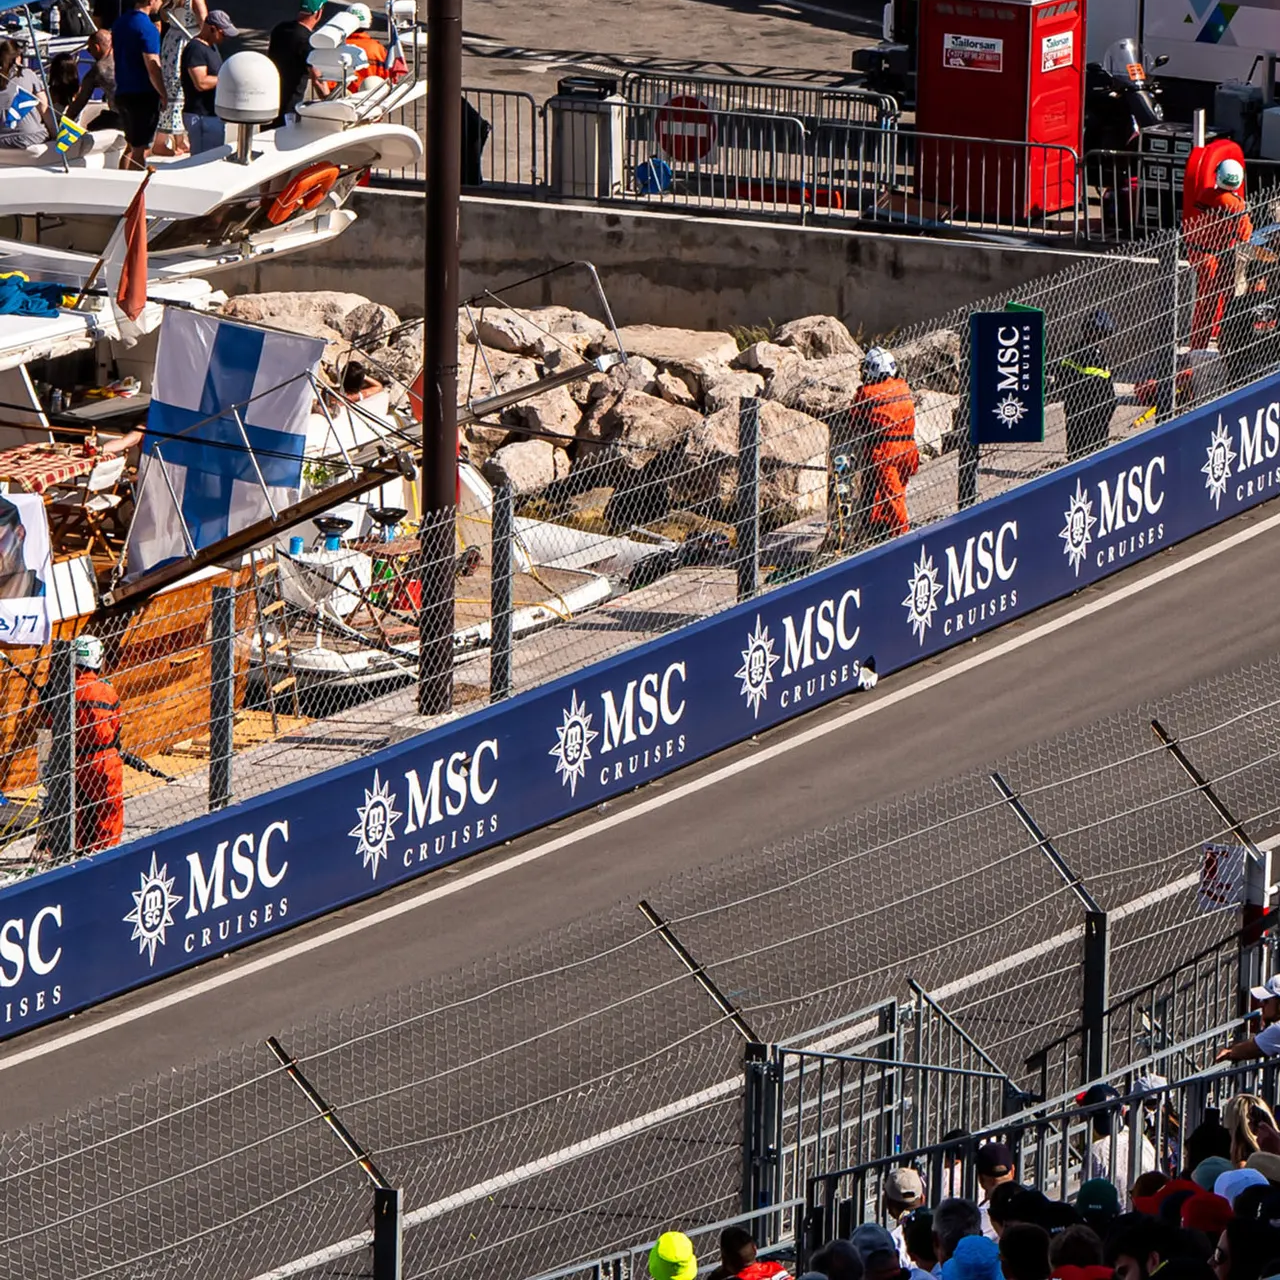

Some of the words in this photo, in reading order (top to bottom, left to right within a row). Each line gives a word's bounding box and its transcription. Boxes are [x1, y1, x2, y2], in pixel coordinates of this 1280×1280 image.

[952, 36, 996, 50] Tailorsan
[998, 327, 1019, 391] MSC
[1098, 456, 1164, 539] MSC
[945, 521, 1017, 606] MSC
[1097, 519, 1163, 567] CRUISES
[782, 589, 860, 677] MSC
[944, 584, 1016, 635] CRUISES
[601, 662, 685, 757] MSC
[781, 654, 859, 707] CRUISES
[601, 729, 684, 786] CRUISES
[405, 739, 497, 839] MSC
[404, 810, 497, 866] CRUISES
[186, 820, 288, 924] MSC
[0, 905, 62, 986] SC
[185, 893, 287, 952] CRUISES
[5, 985, 61, 1020] ISES
